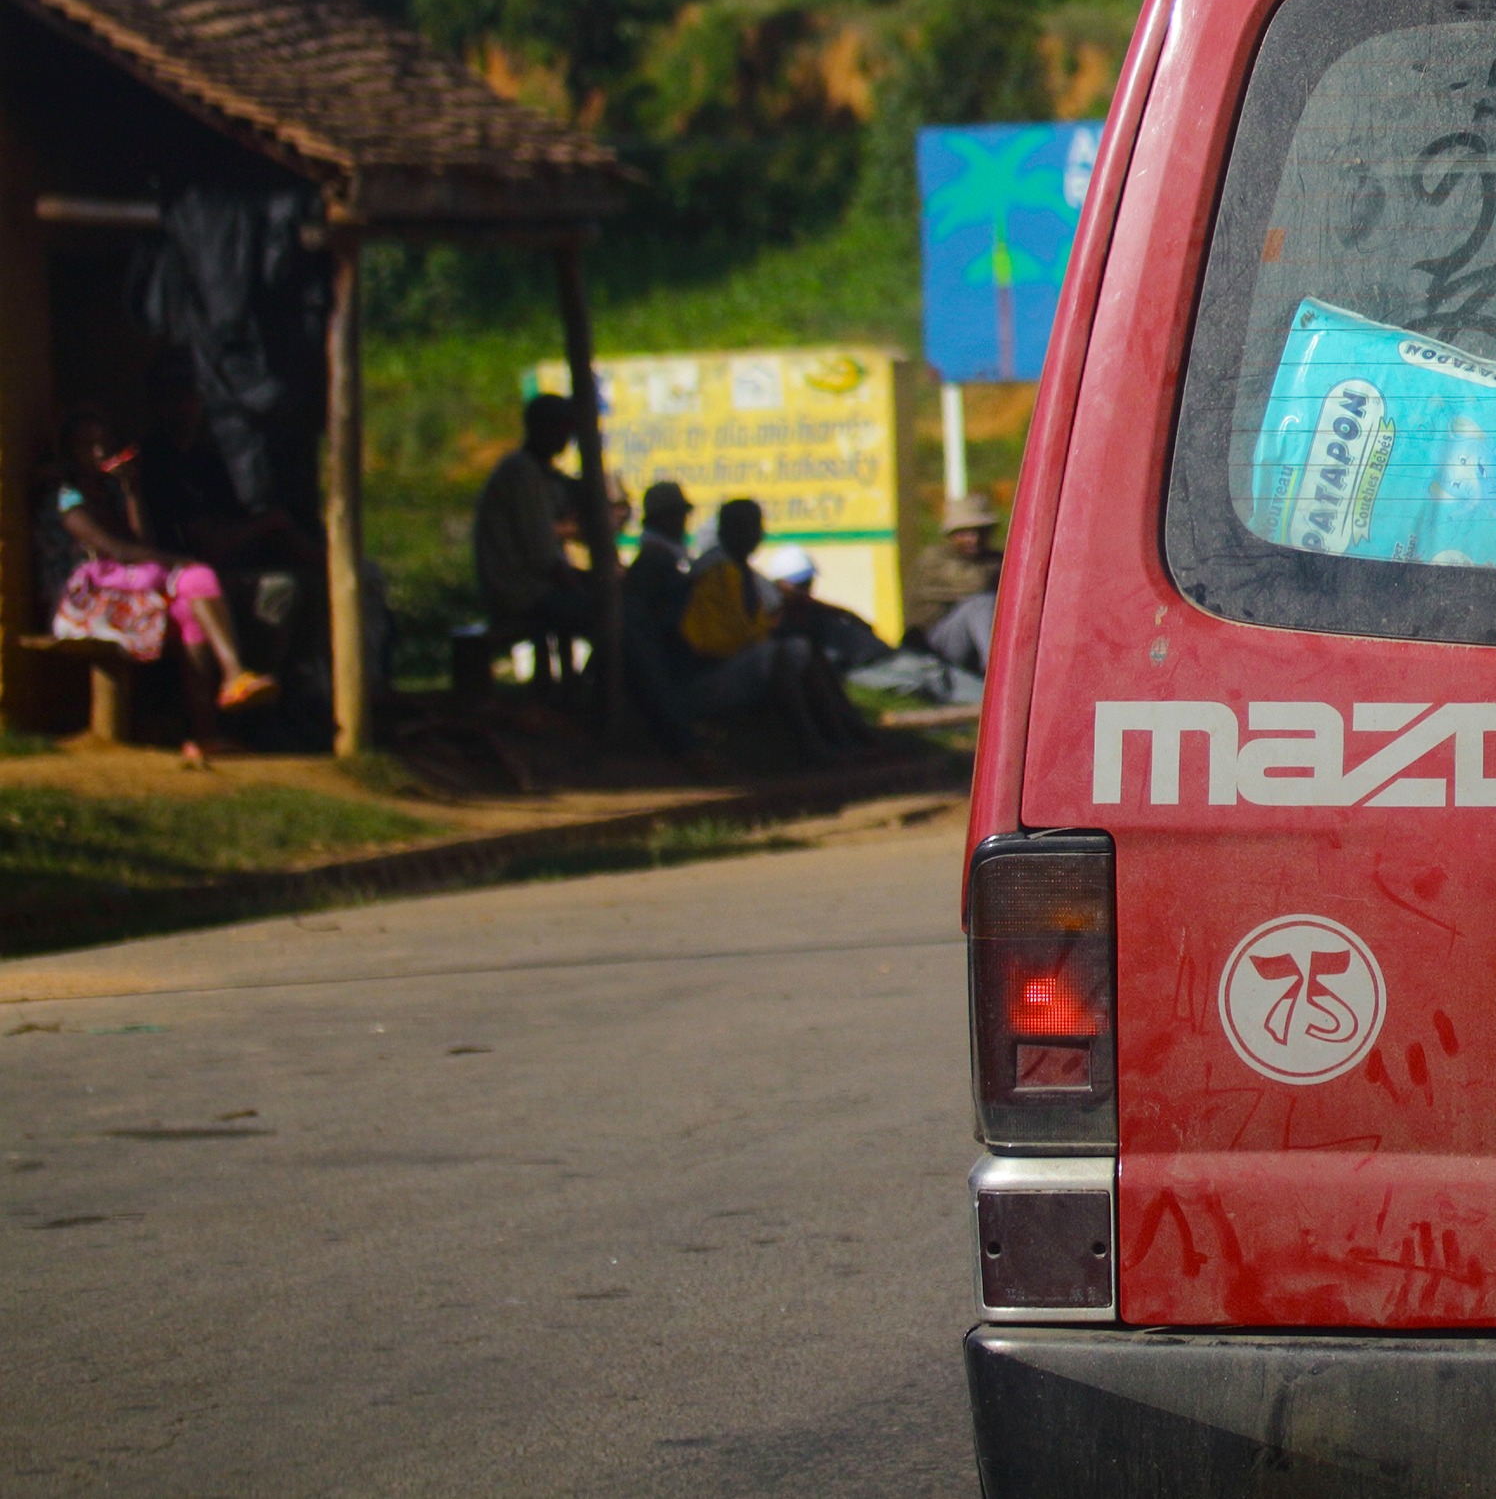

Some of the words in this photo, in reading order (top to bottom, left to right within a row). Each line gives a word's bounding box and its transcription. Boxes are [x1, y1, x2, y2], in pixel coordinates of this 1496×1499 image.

[1301, 388, 1371, 552] PATAPON
[1354, 476, 1380, 528] Couches
[1370, 433, 1394, 473] Bébés
[1249, 949, 1359, 1046] 75
